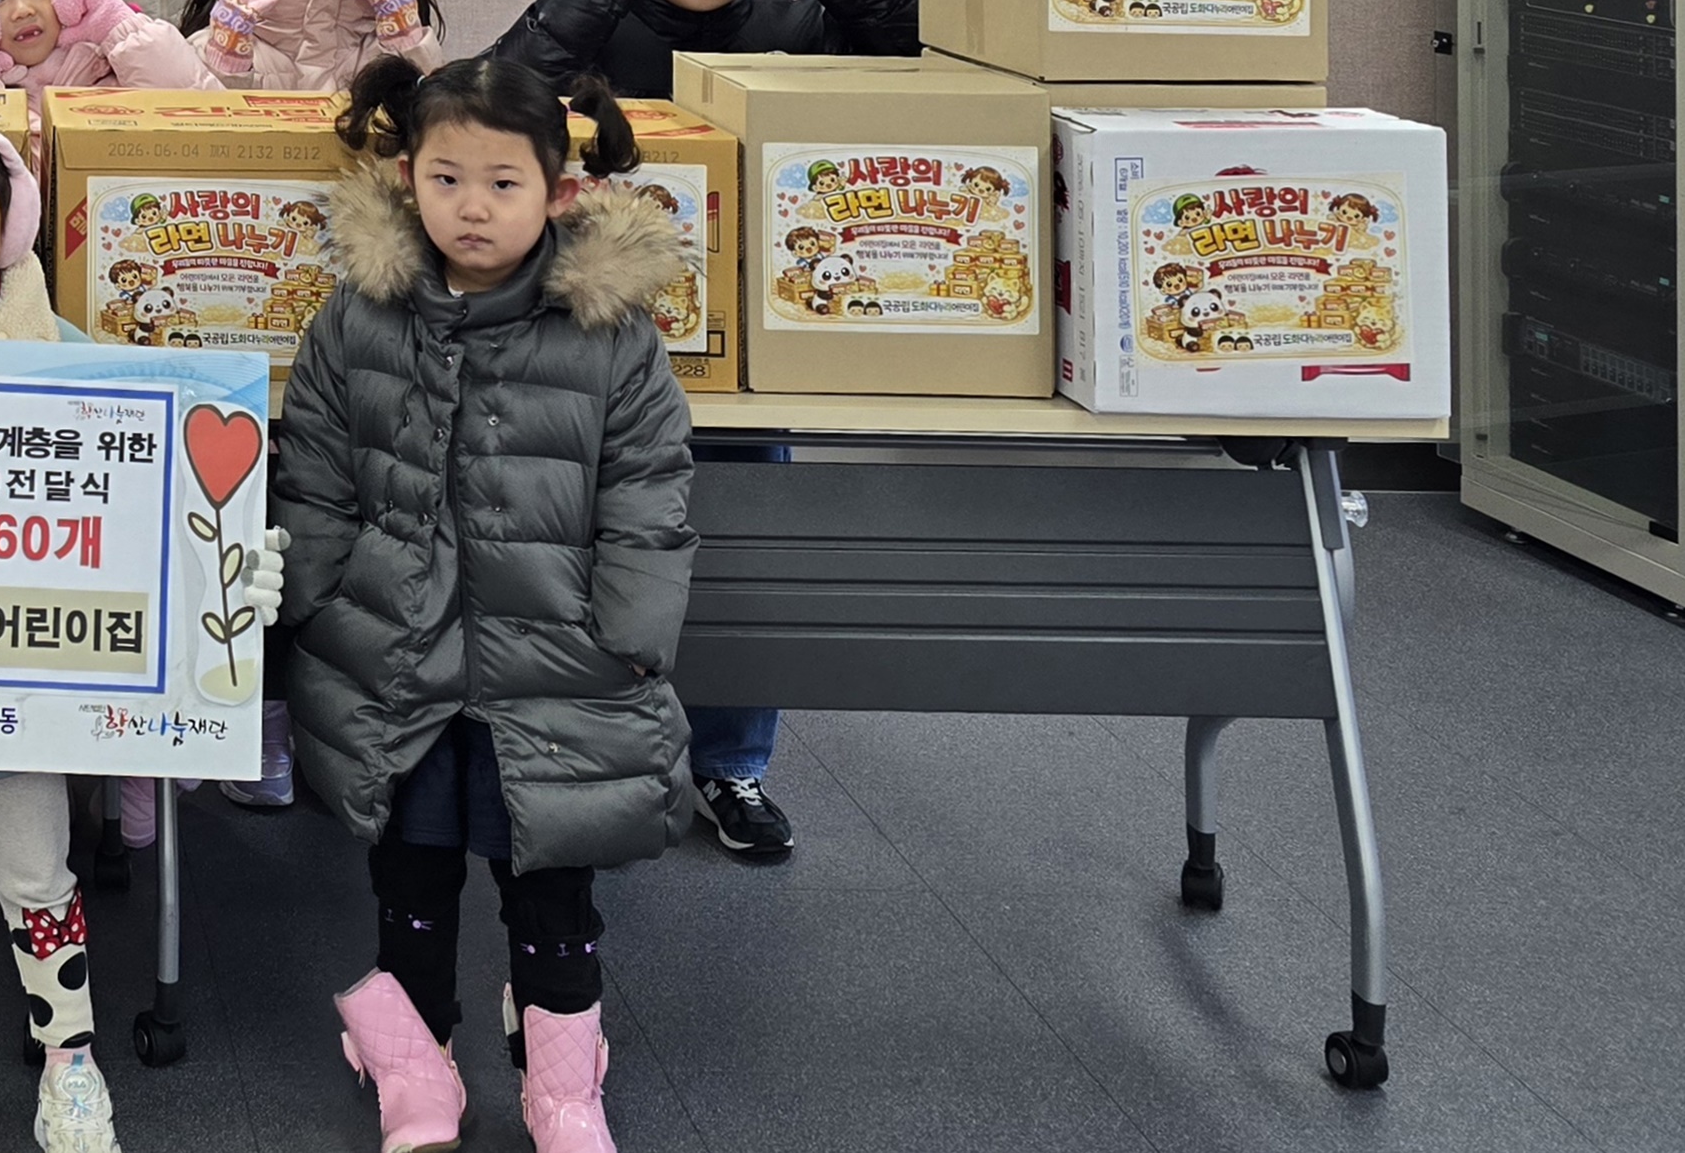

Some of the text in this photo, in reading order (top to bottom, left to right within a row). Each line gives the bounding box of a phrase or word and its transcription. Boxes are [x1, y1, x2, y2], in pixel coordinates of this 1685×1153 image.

[108, 142, 200, 159] 2026.06.04
[237, 144, 274, 160] 2132
[283, 146, 321, 160] B212
[846, 156, 942, 187] 사랑의
[167, 190, 260, 220] 사랑의
[824, 186, 982, 223] 라면 나누기
[1211, 187, 1308, 218] 사랑의
[146, 220, 299, 256] 라면 나누기
[1190, 218, 1351, 255] 라면 나누기
[883, 300, 910, 312] 국공립
[203, 332, 229, 344] 국공립
[97, 431, 157, 464] 위한
[105, 704, 228, 746] 학산나눔재단
